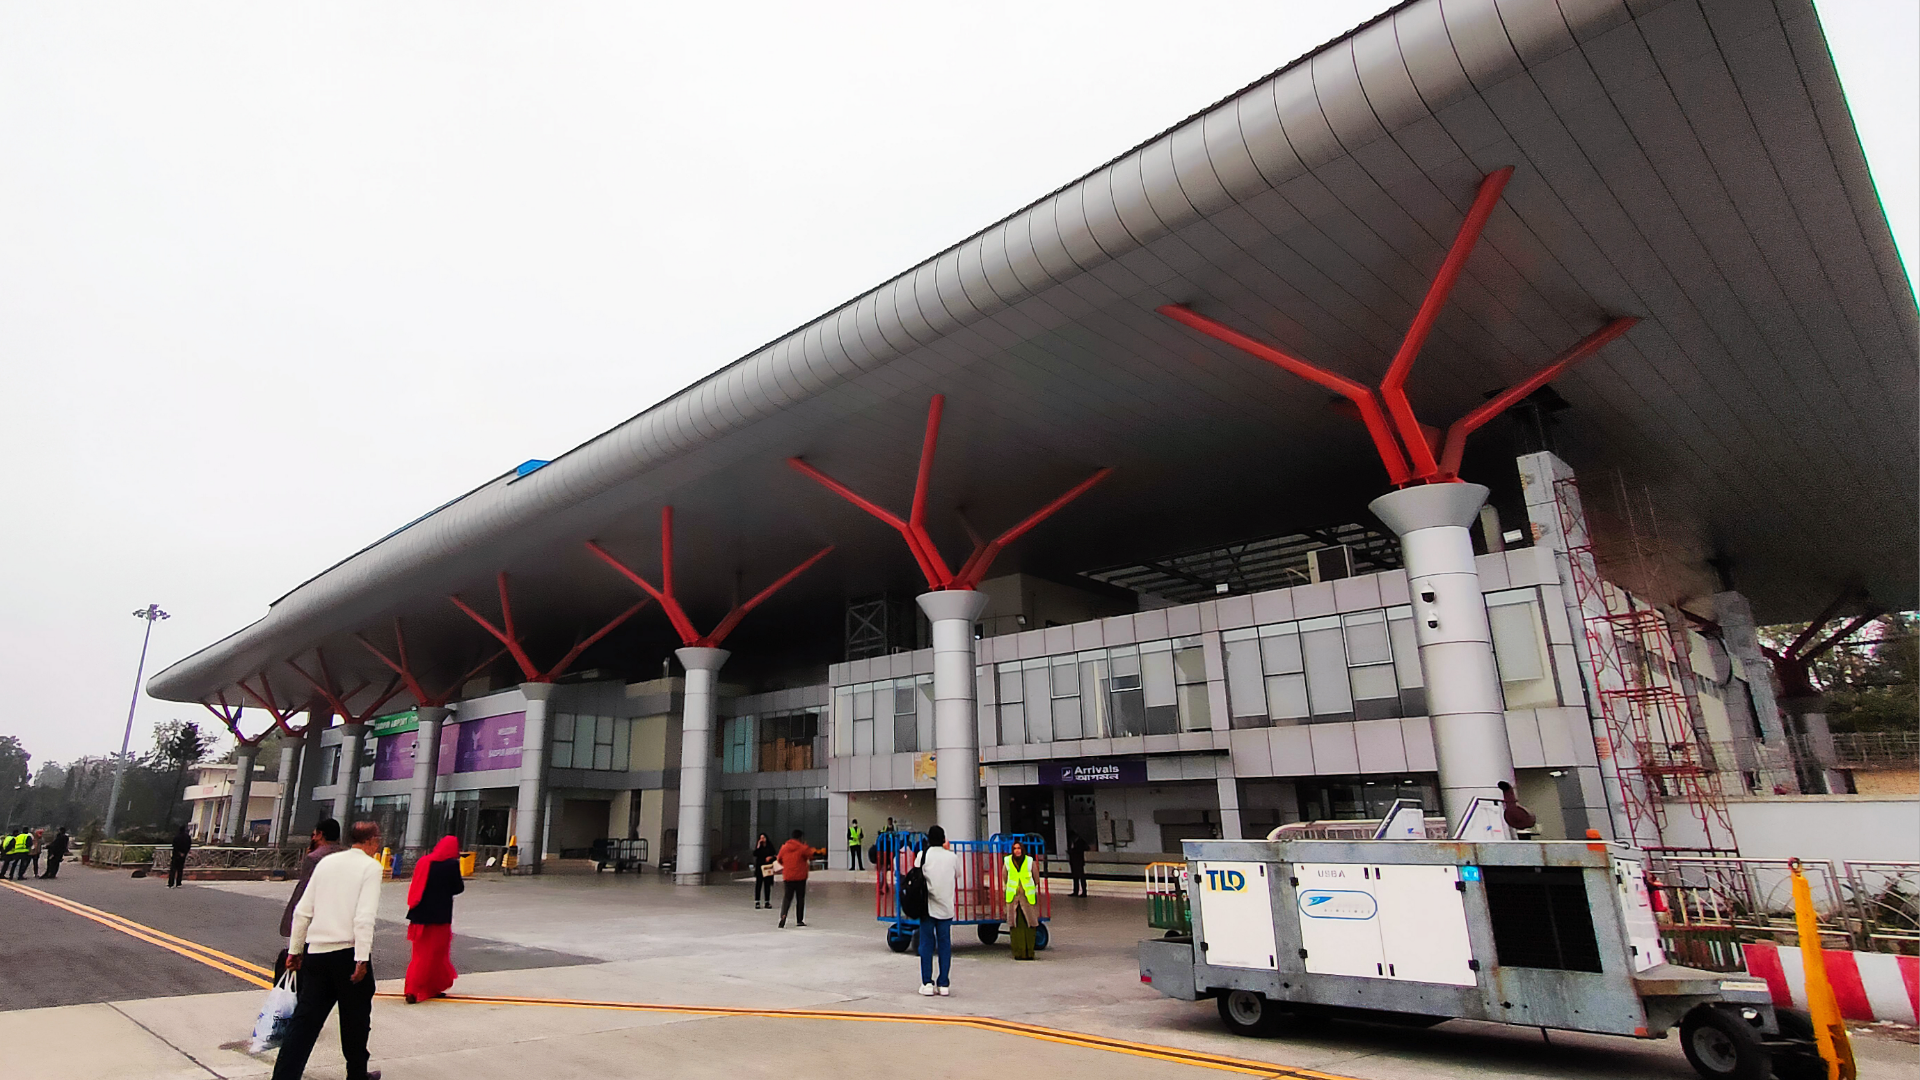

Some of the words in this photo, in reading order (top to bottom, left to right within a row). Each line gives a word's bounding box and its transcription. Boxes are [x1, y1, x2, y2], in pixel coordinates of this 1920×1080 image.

[1074, 765, 1119, 774] Arrivals
[1317, 870, 1346, 878] USBA
[1206, 870, 1245, 891] TLD
